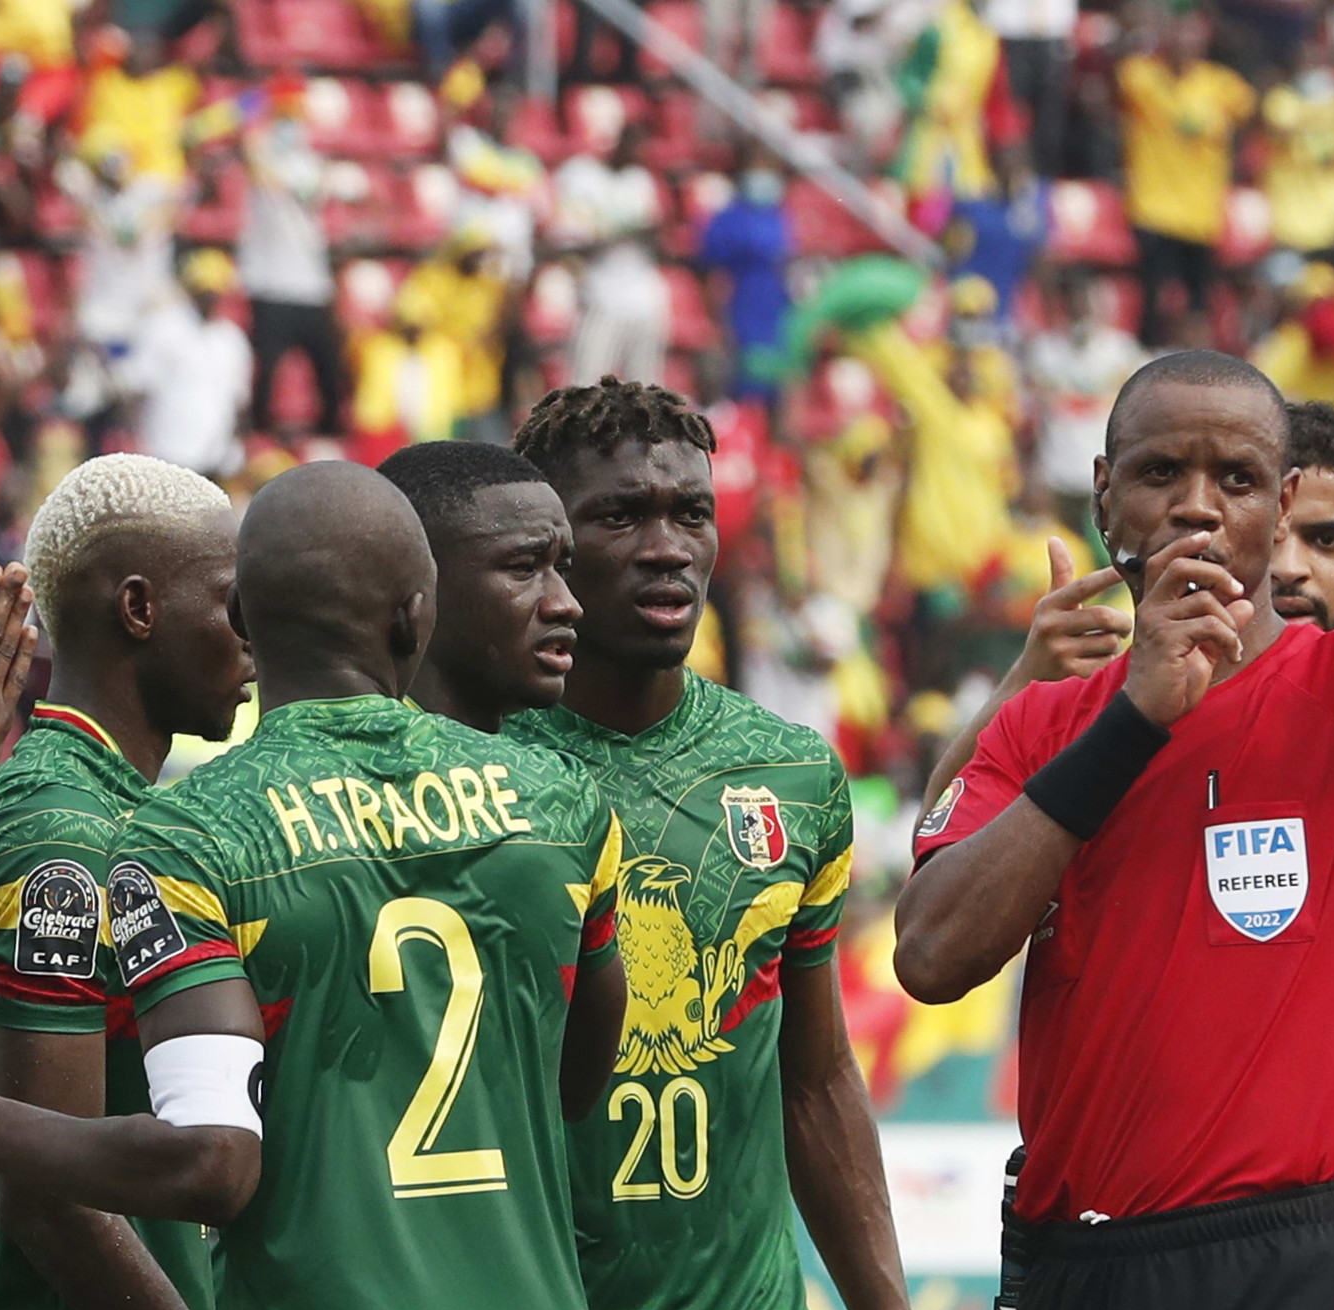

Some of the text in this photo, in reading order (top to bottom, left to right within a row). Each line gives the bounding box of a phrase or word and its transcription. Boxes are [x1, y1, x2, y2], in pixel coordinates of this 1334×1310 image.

[267, 764, 532, 858] H.TRAORE
[1214, 826, 1295, 858] FIFA
[1218, 873, 1299, 892] REFEREE
[23, 907, 97, 930] Celebrate
[35, 922, 80, 939] Africa
[1244, 913, 1281, 928] 2022
[33, 952, 80, 966] CAF
[127, 938, 167, 970] CAF
[368, 897, 508, 1199] 2
[608, 1076, 710, 1202] 20
